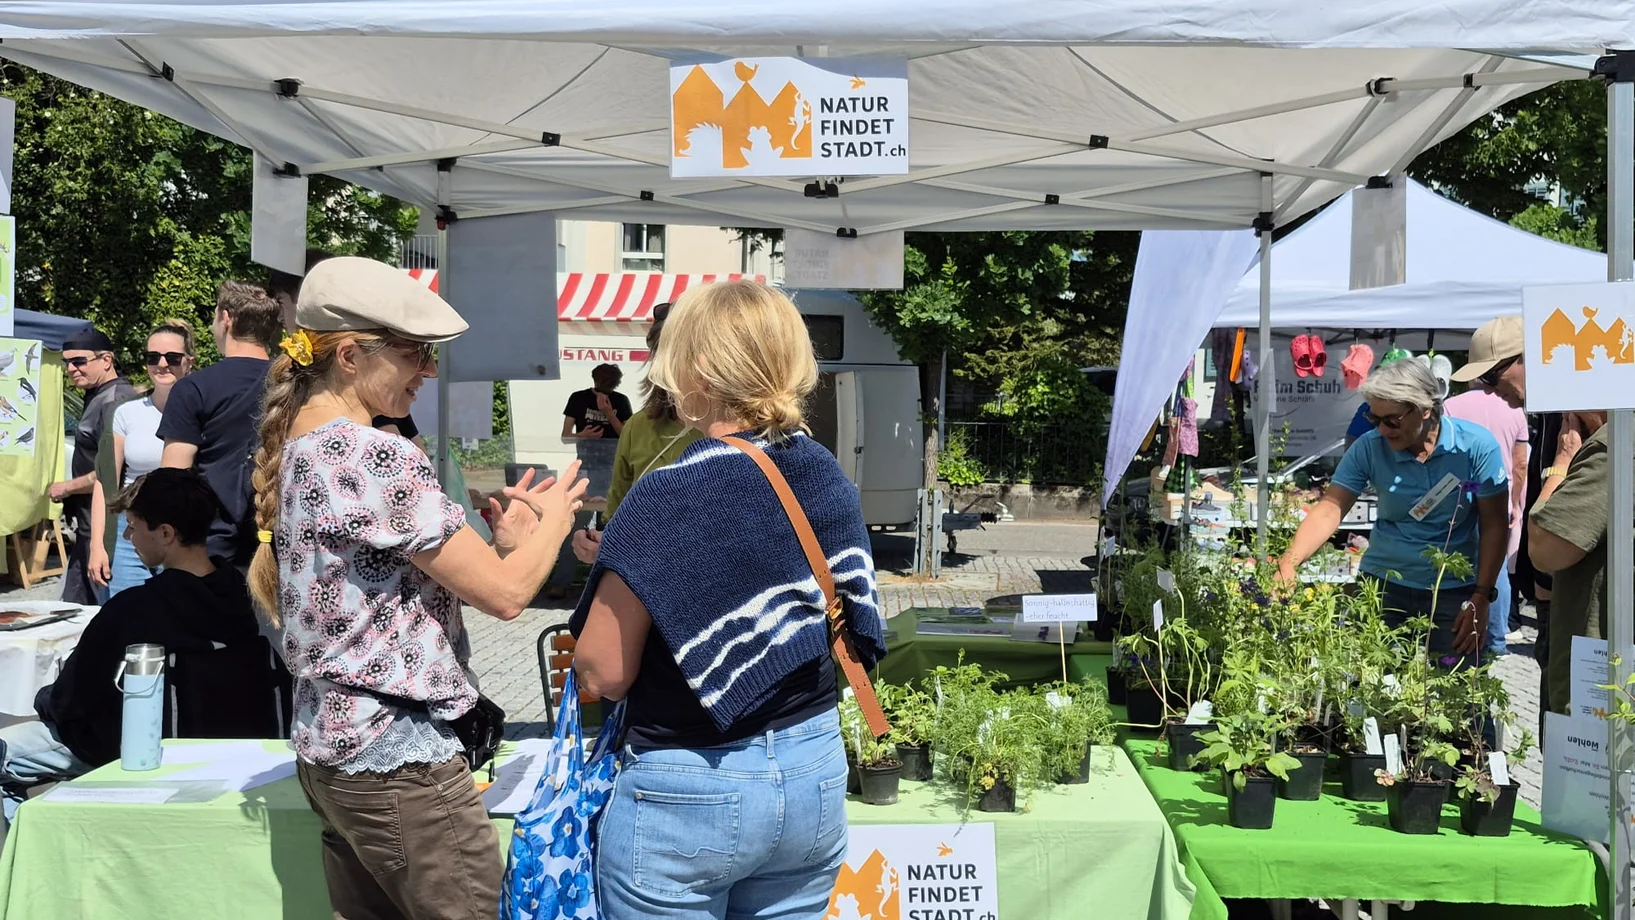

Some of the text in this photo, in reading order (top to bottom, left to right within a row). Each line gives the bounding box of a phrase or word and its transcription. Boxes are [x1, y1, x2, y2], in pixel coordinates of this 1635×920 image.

[820, 97, 889, 113] NATUR
[821, 118, 895, 136] FINDET
[821, 141, 906, 158] STADT.ch
[560, 349, 624, 361] STANG
[1296, 379, 1341, 394] Schuh
[1593, 649, 1608, 657] hlen
[1567, 735, 1599, 751] Wohlen
[907, 864, 977, 880] NATUR
[908, 886, 983, 903] FINDET
[908, 908, 996, 920] STADTch
